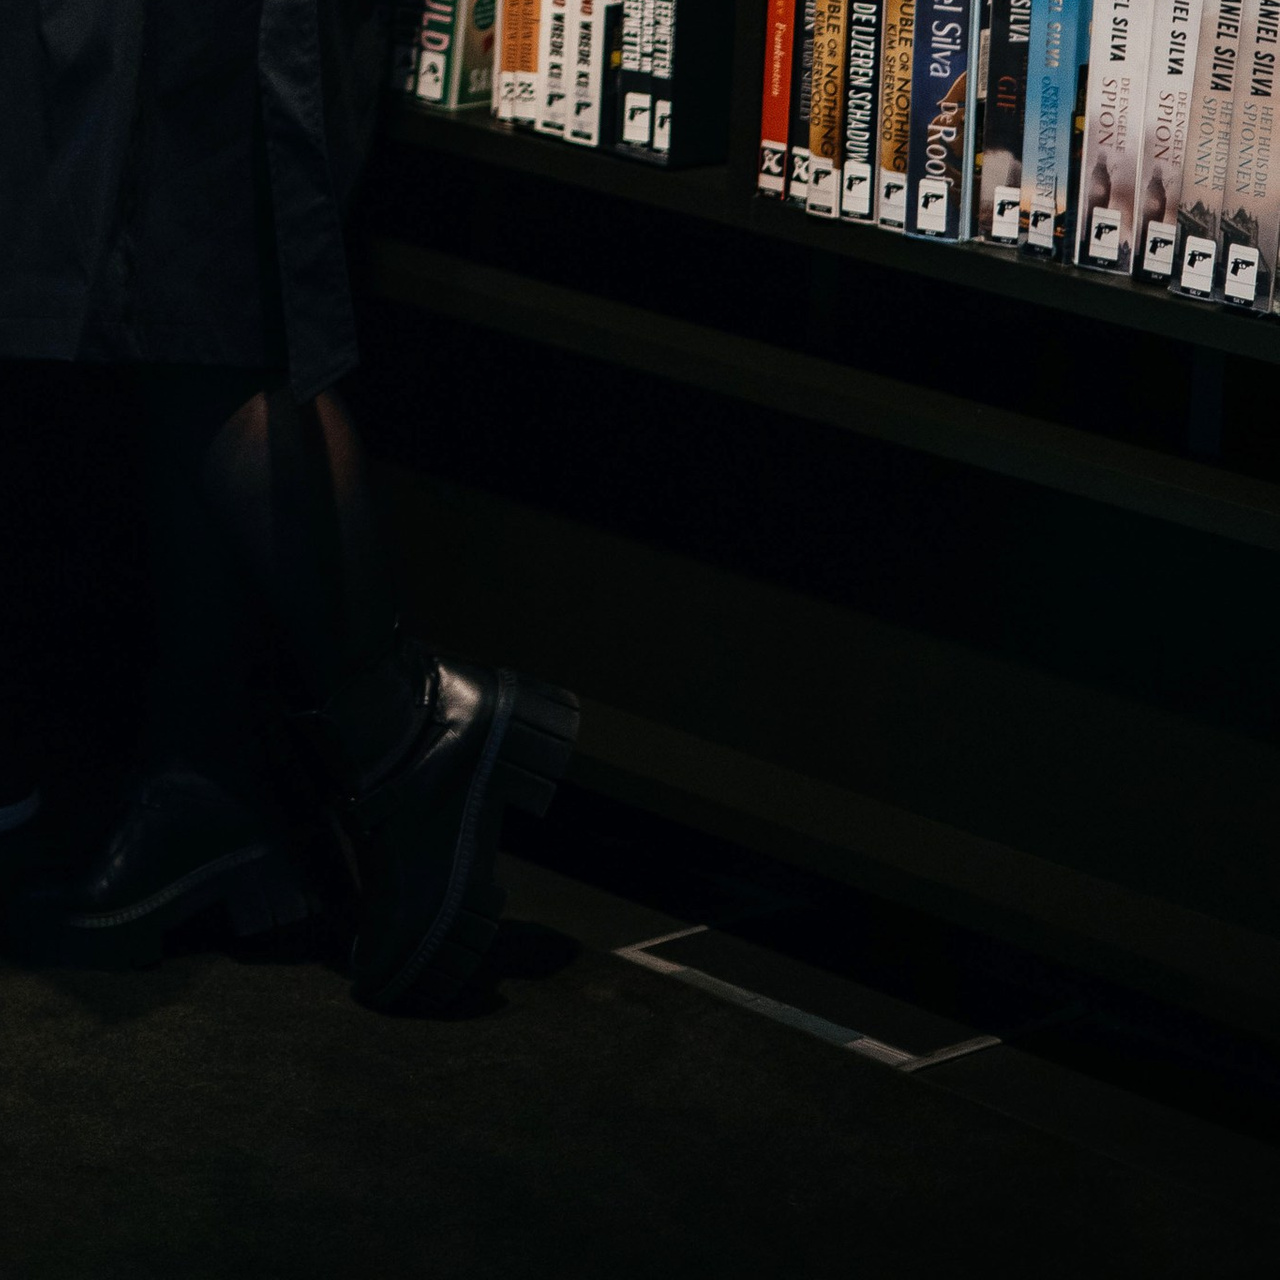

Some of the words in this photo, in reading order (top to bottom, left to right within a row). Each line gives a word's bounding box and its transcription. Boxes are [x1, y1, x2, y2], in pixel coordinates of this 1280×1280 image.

[852, 2, 877, 23] DE
[1109, 17, 1129, 61] SILVA
[848, 25, 876, 89] IJZEREN
[928, 20, 962, 78] Silva
[1167, 29, 1187, 75] SILVA
[1210, 45, 1236, 92] SILVA
[1250, 50, 1276, 97] SILVA
[820, 63, 839, 158] NOTHING
[881, 55, 897, 141] SHERWOOD
[891, 77, 912, 172] NOTHING
[1097, 76, 1118, 151] SPION
[1153, 89, 1175, 162] SPION
[1193, 95, 1218, 188] SPIONNEN
[1235, 100, 1258, 195] SPIONNEN
